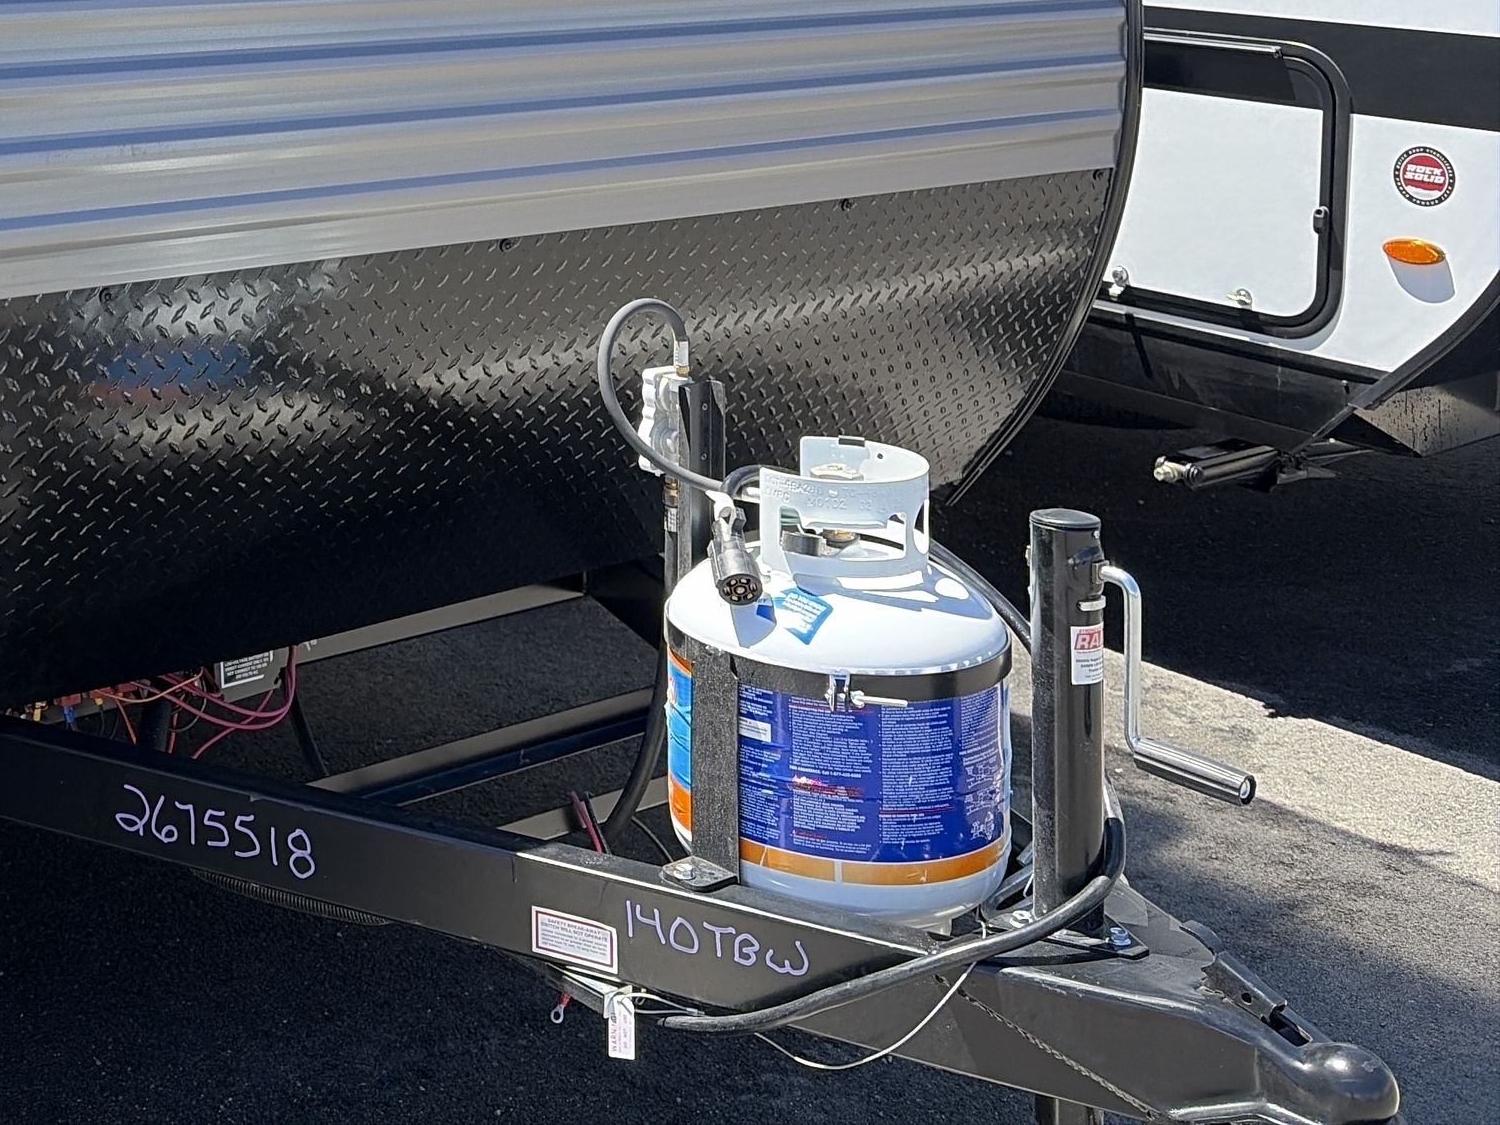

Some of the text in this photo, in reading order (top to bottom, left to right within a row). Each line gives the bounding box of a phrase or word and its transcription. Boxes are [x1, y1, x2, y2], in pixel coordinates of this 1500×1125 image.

[1404, 172, 1445, 184] SOLID
[115, 784, 316, 879] 2675518
[626, 900, 810, 976] 140TBW
